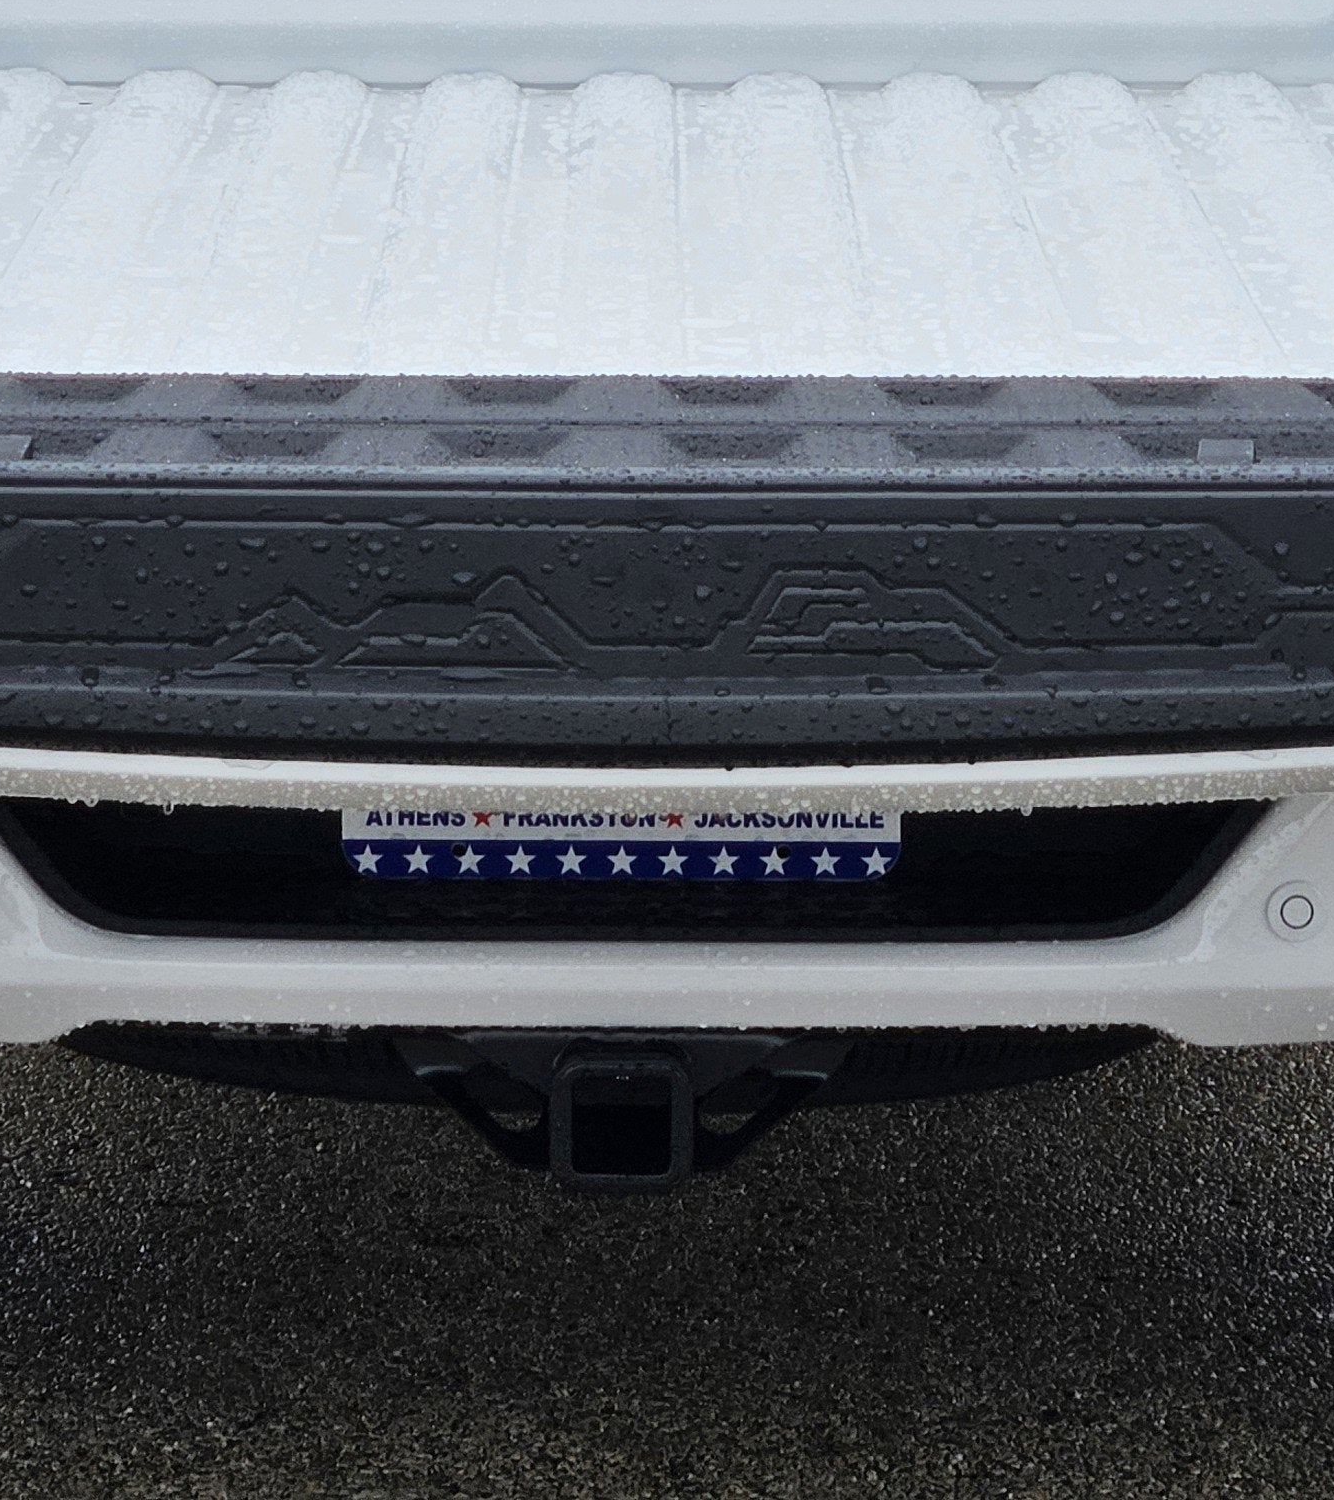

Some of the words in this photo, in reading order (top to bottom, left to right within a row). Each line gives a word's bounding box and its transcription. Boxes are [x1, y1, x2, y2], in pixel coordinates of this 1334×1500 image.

[366, 810, 465, 827] ATHENS
[503, 810, 655, 828] FRANKSTON
[694, 810, 884, 828] JACKSONVILLE
